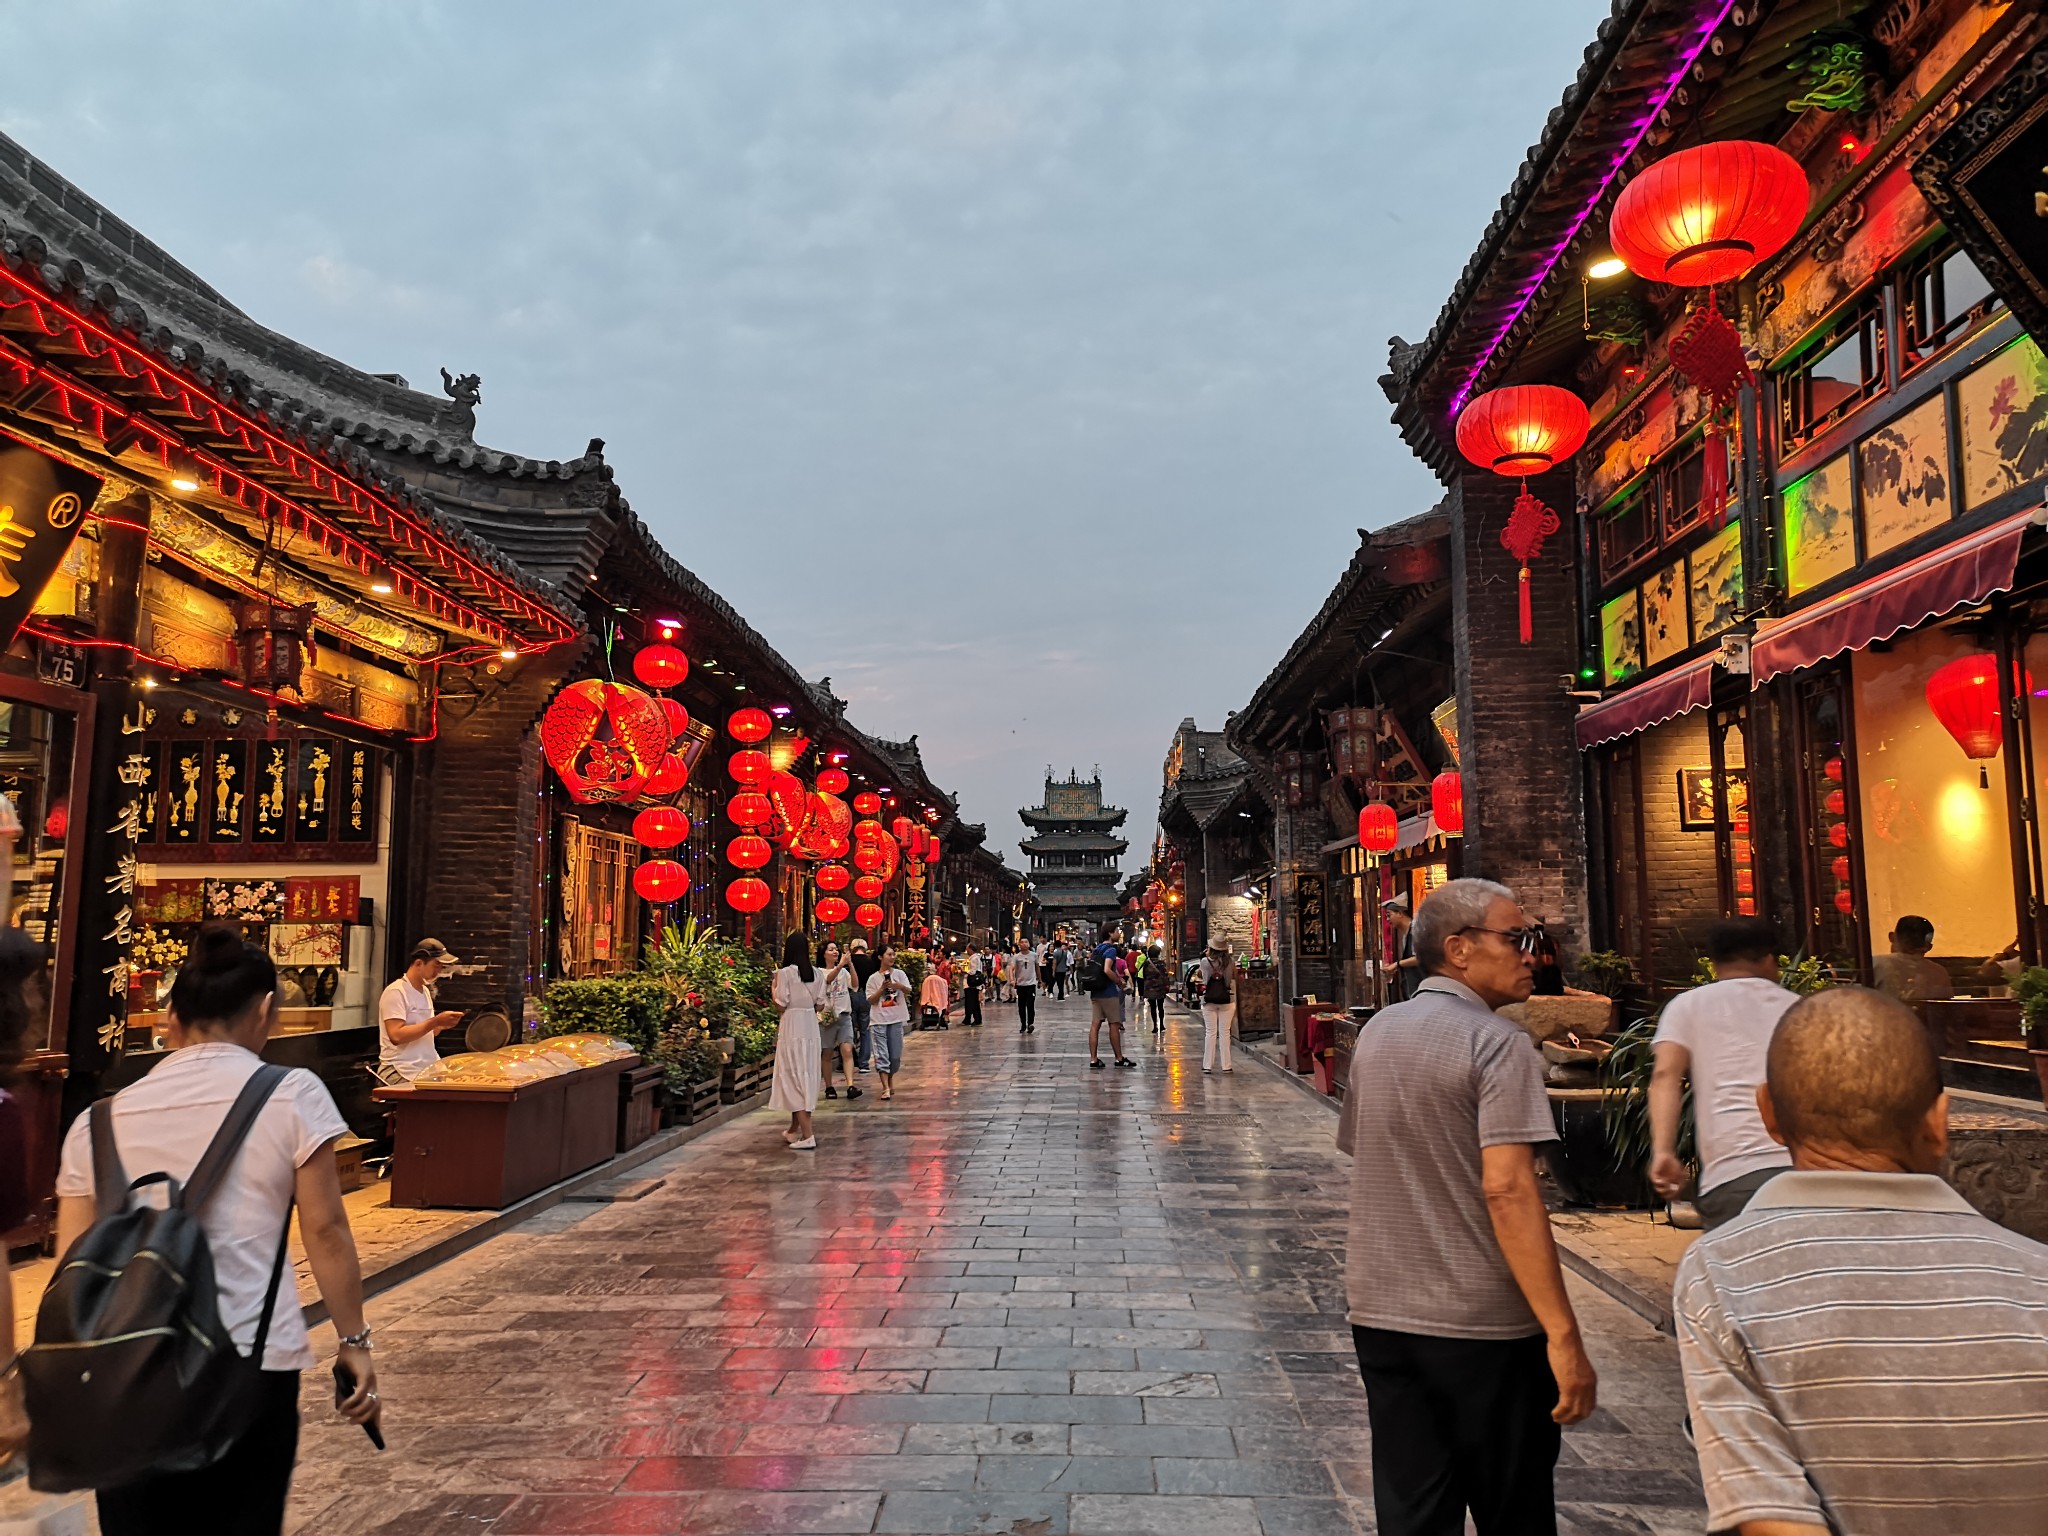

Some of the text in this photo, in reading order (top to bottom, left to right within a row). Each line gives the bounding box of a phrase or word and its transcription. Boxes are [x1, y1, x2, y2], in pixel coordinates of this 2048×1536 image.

[52, 657, 74, 682] 75
[1300, 879, 1322, 935] 德居源
